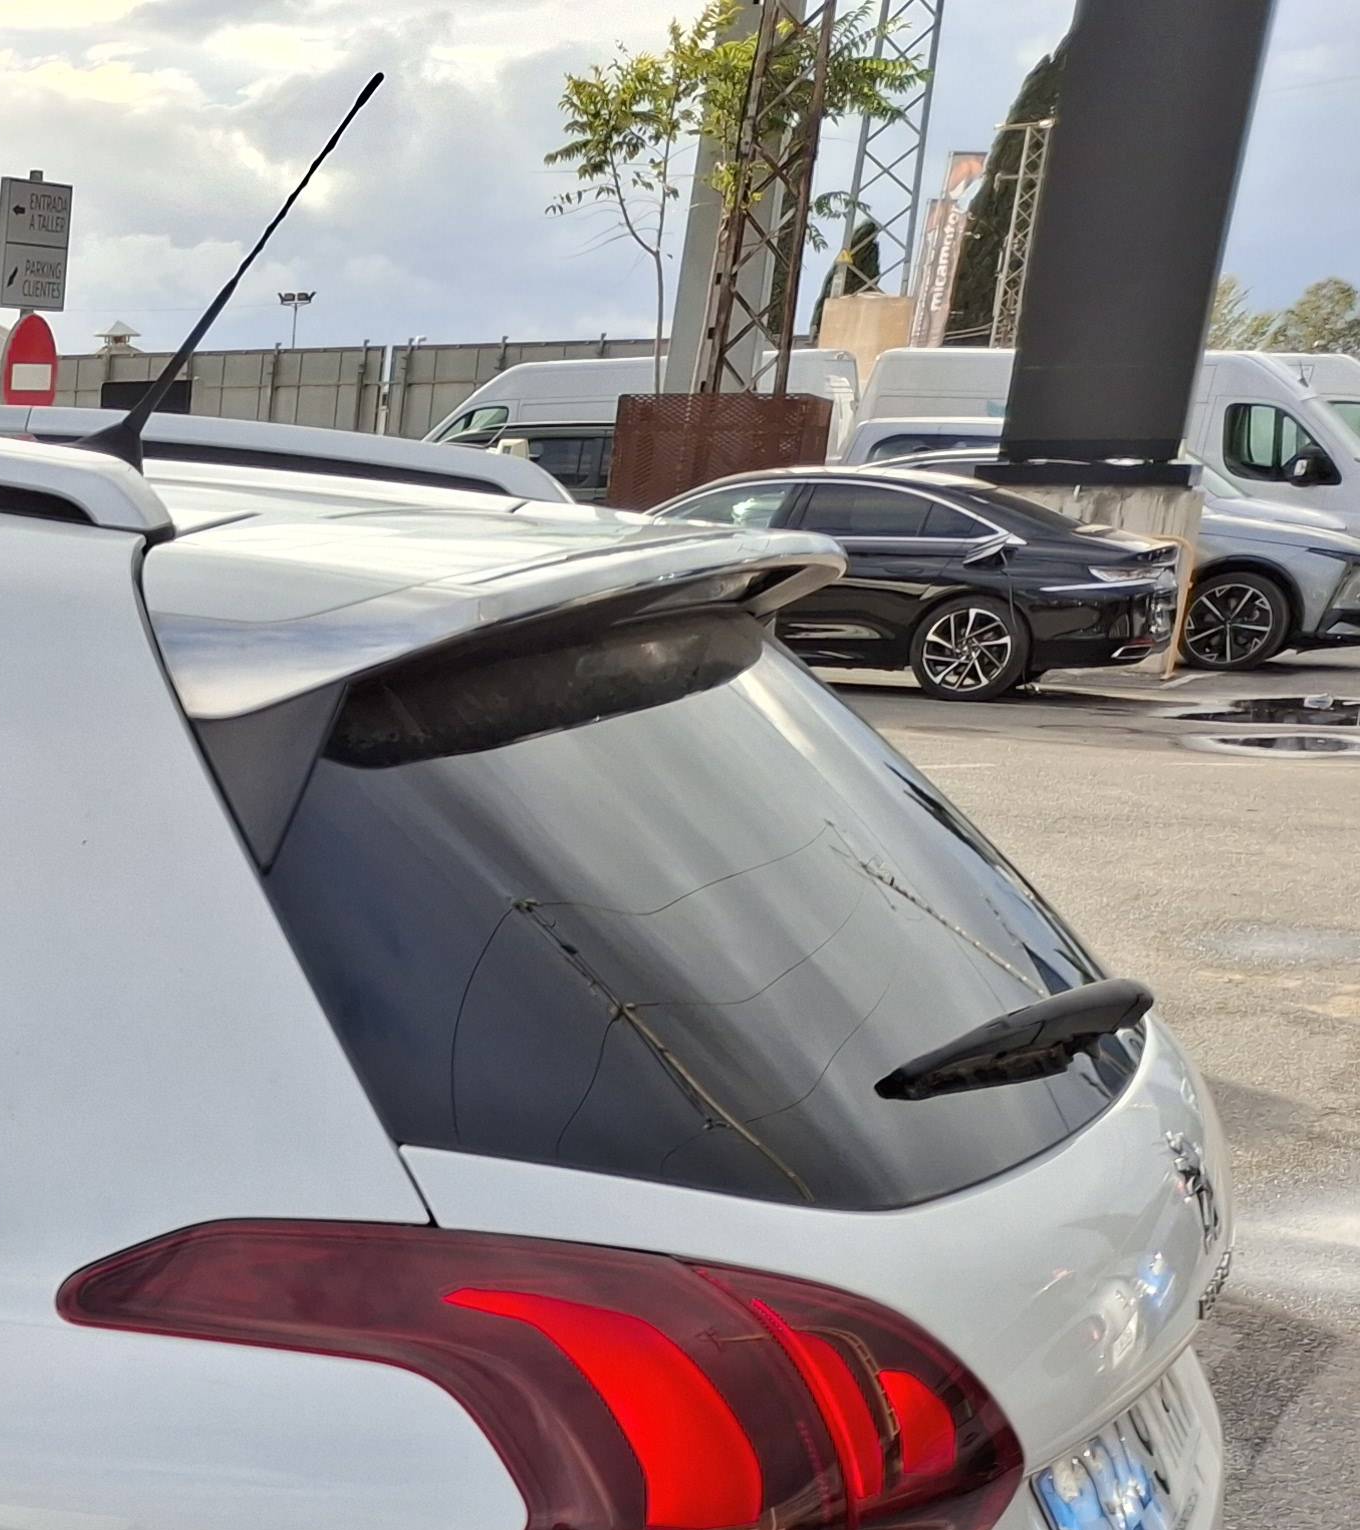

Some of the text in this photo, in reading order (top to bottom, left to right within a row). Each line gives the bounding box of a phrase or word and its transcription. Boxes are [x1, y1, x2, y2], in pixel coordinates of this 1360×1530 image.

[30, 192, 67, 211] ENTRADA
[29, 214, 65, 233] A TALLER
[24, 259, 62, 279] PARKING
[22, 279, 61, 299] CLIENTES
